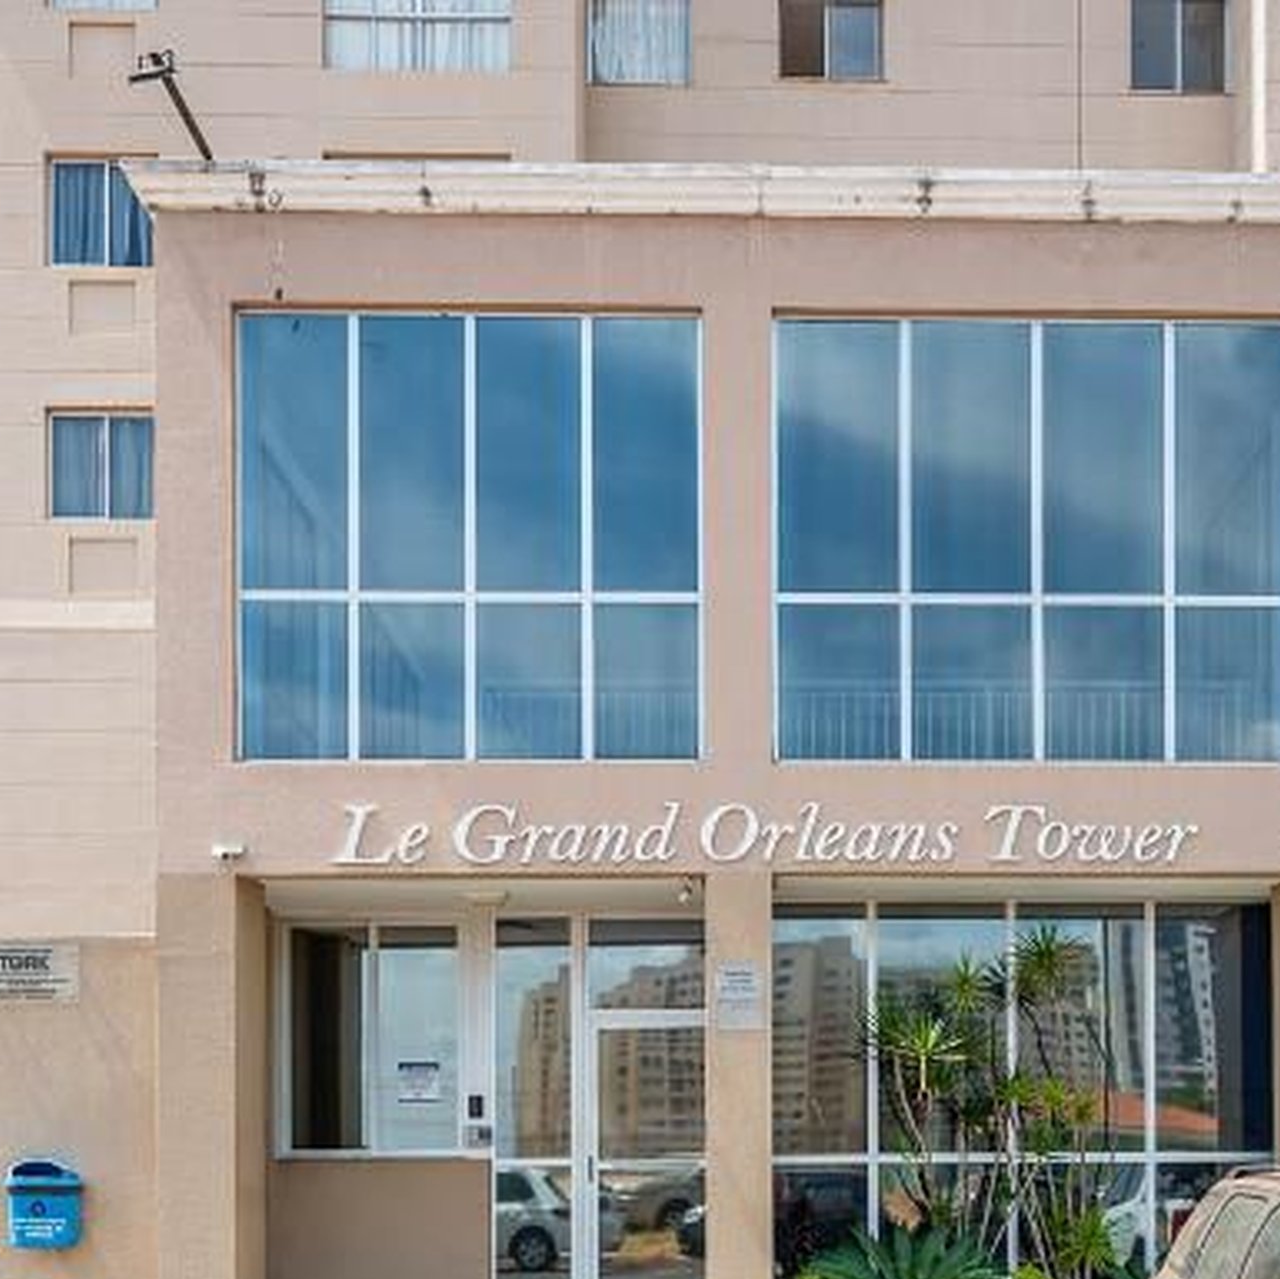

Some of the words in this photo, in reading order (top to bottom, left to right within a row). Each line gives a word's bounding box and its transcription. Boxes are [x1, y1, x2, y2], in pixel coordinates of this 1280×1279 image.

[328, 802, 429, 866] Le
[452, 801, 680, 866] Grand
[700, 801, 958, 865] Orleans
[983, 803, 1199, 865] Tower
